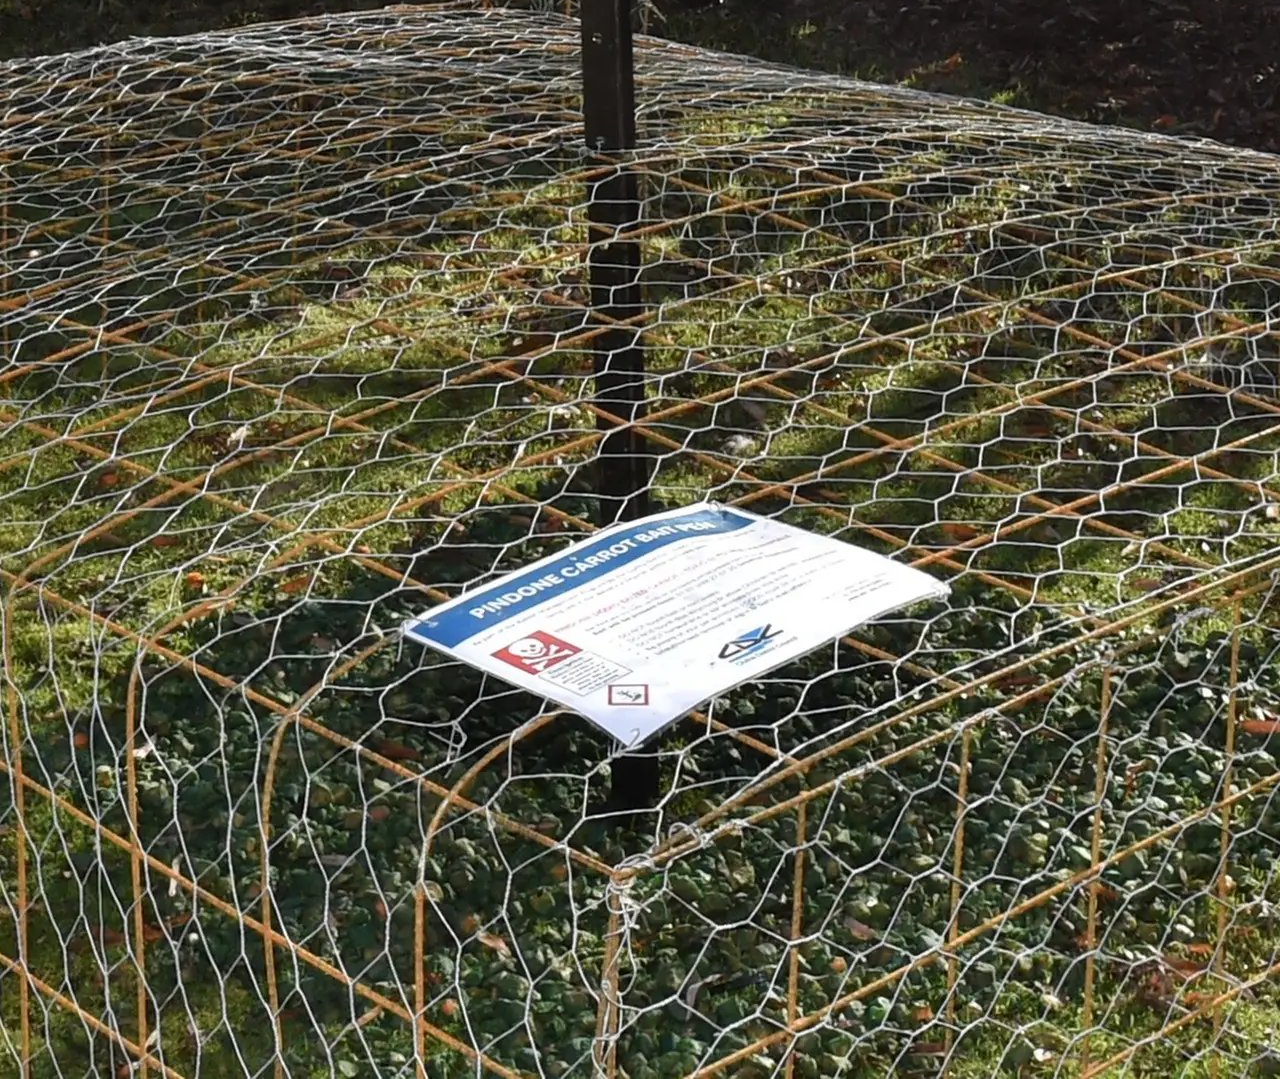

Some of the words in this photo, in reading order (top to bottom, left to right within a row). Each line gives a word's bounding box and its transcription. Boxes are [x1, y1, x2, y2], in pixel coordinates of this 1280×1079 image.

[469, 572, 564, 622] PINDONE
[561, 538, 640, 578] CARROT
[635, 524, 678, 544] BAIT
[673, 520, 715, 533] PEN
